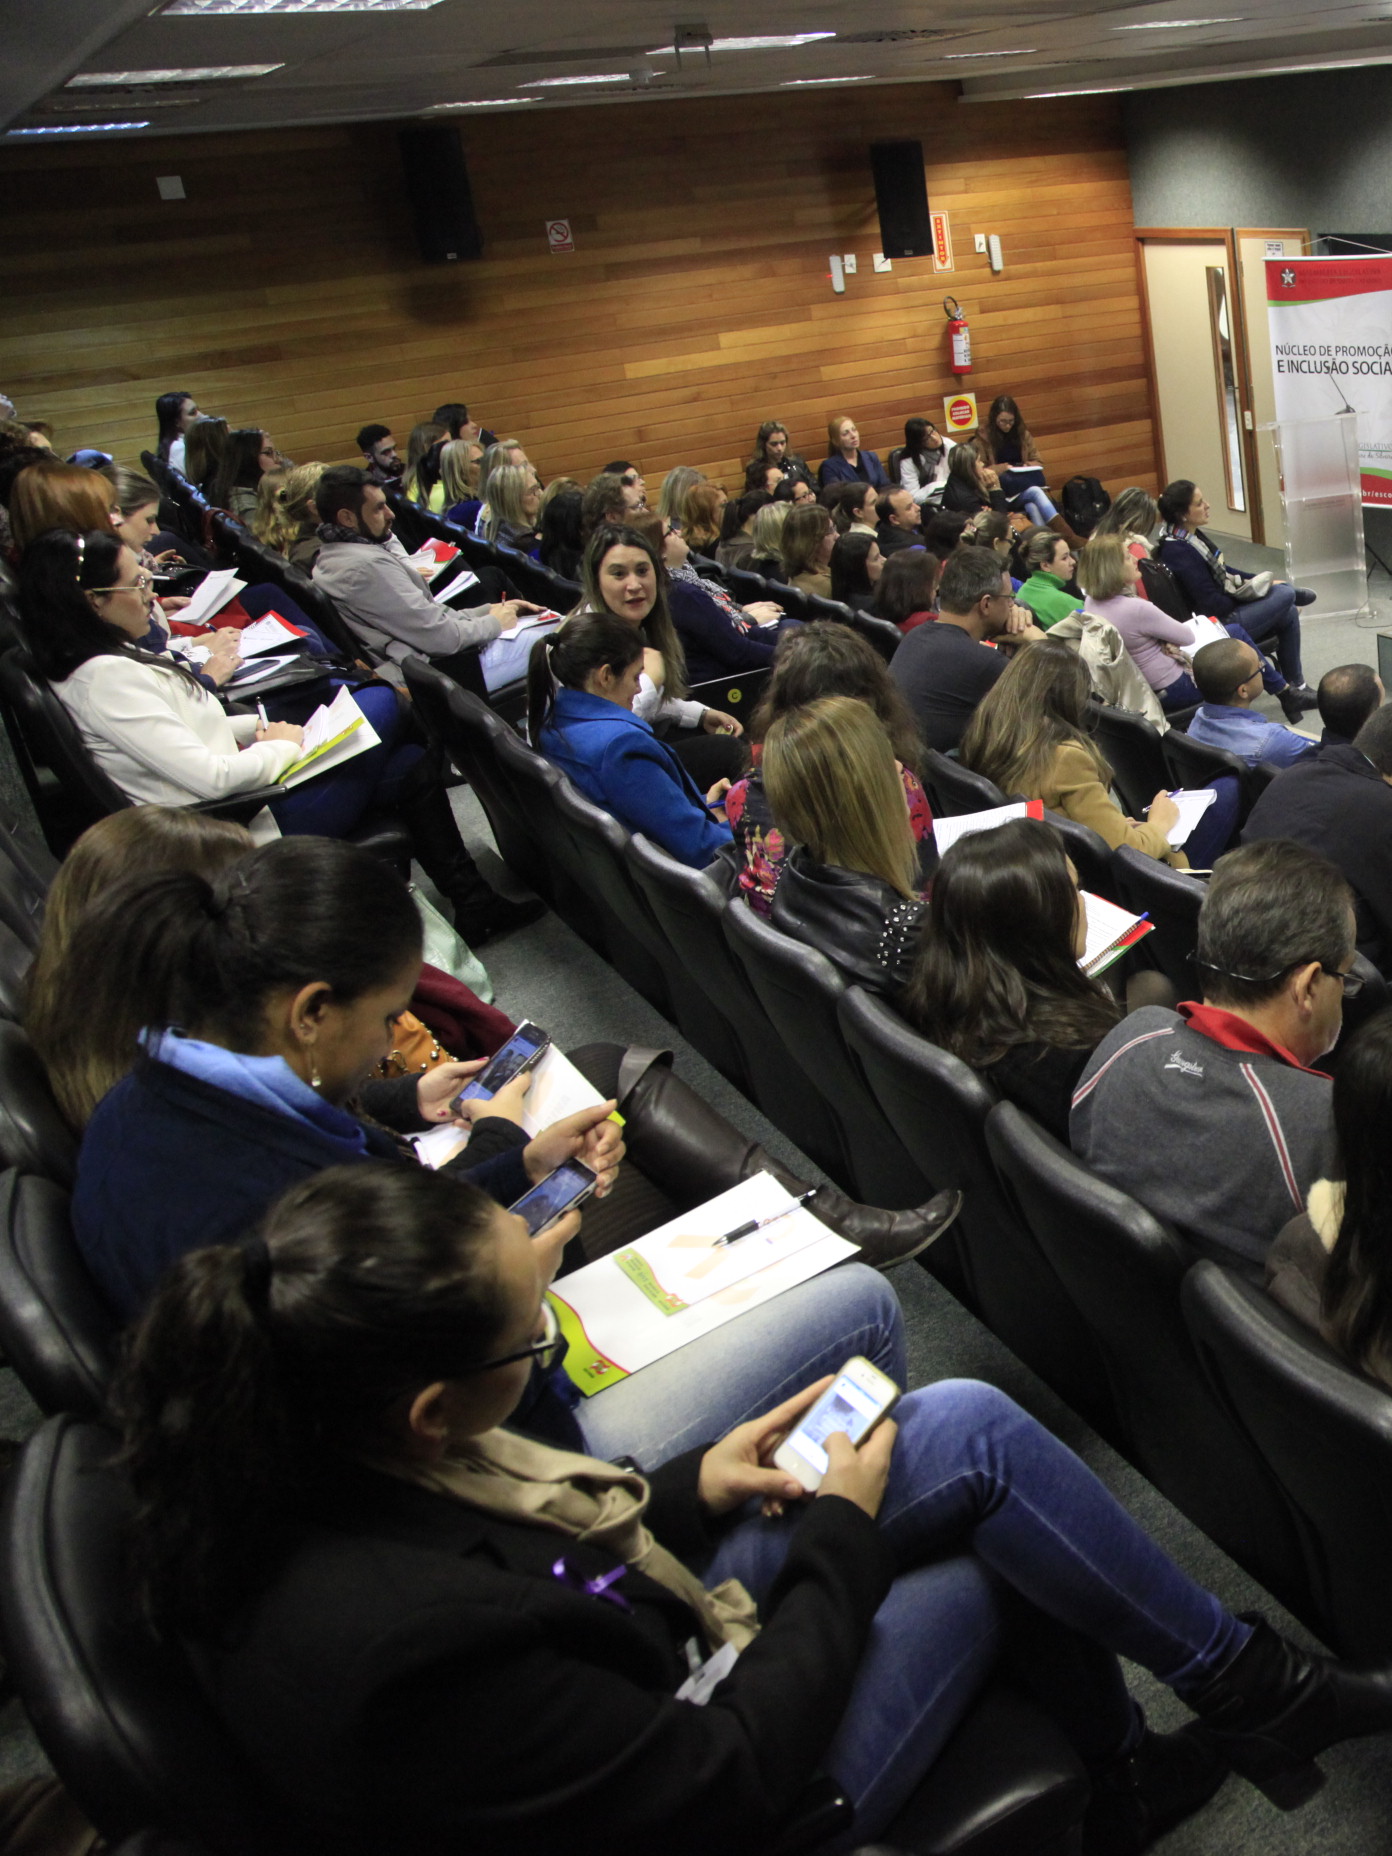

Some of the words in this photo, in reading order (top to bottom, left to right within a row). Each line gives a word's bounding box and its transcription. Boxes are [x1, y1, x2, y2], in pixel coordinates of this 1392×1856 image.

[1275, 343, 1316, 356] NÚCLEO
[1319, 345, 1333, 356] DE
[1277, 360, 1285, 373] E
[1287, 358, 1349, 374] INCLUSÃO
